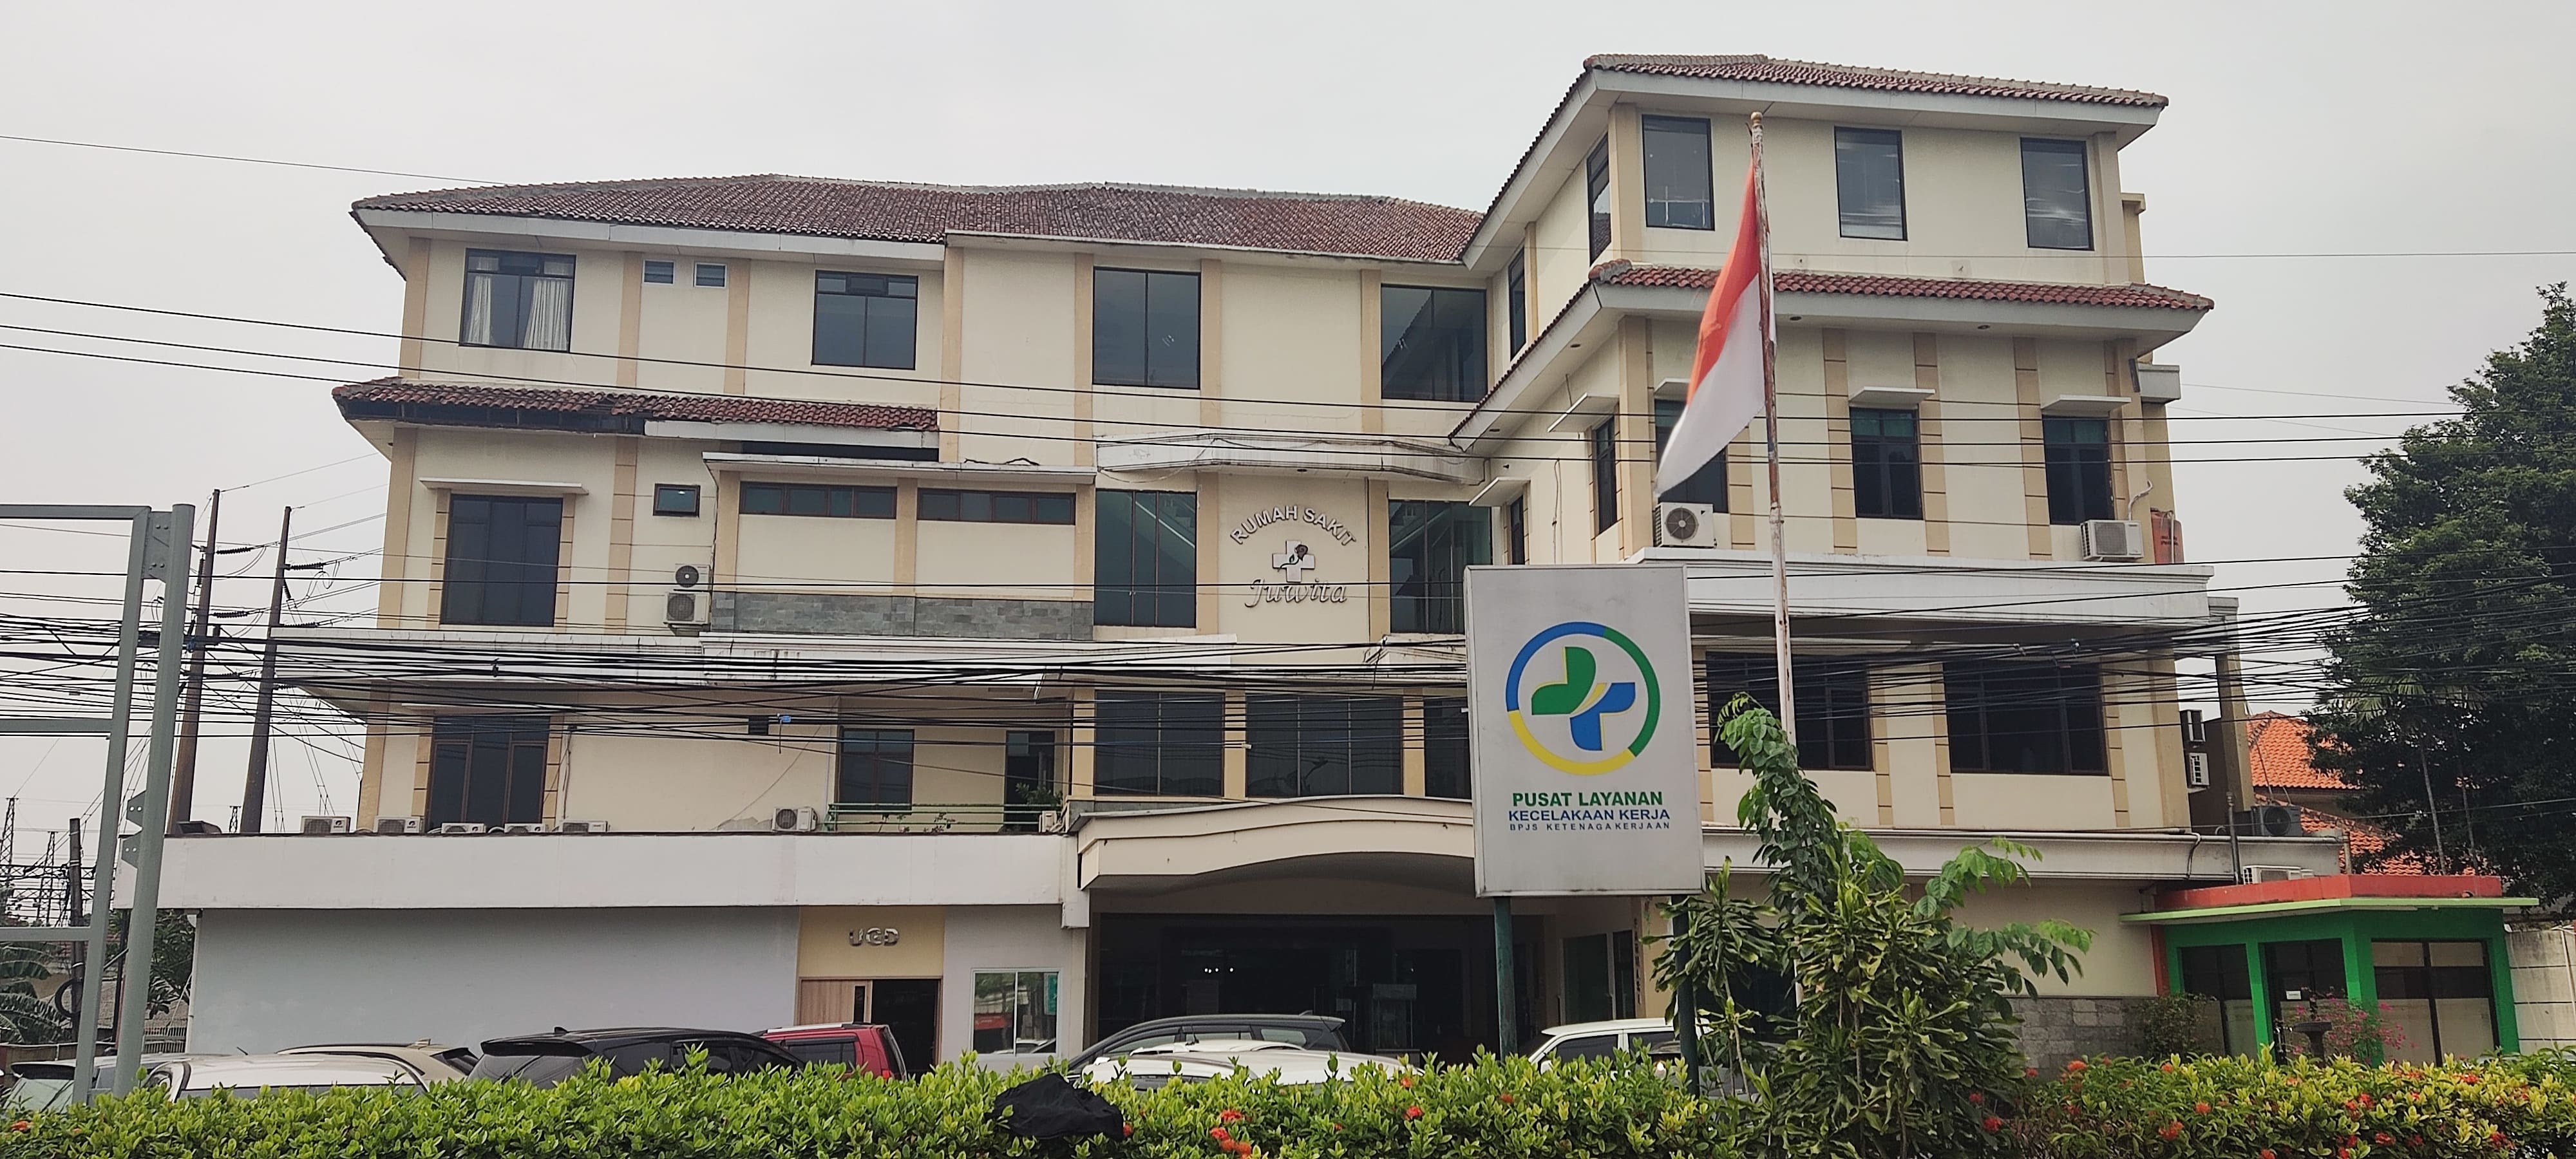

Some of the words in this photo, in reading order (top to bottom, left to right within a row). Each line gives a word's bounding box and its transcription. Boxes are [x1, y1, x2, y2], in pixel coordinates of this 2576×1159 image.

[1231, 505, 1298, 545] RUMAH
[1303, 507, 1356, 545] SAKIT
[1244, 578, 1347, 608] Juwita
[1512, 793, 1572, 807] PUSAT
[1578, 791, 1663, 806] LAYANAN
[1509, 810, 1614, 821] KECELAKAAN
[1619, 809, 1670, 820] KERJA
[849, 927, 899, 946] UGD
